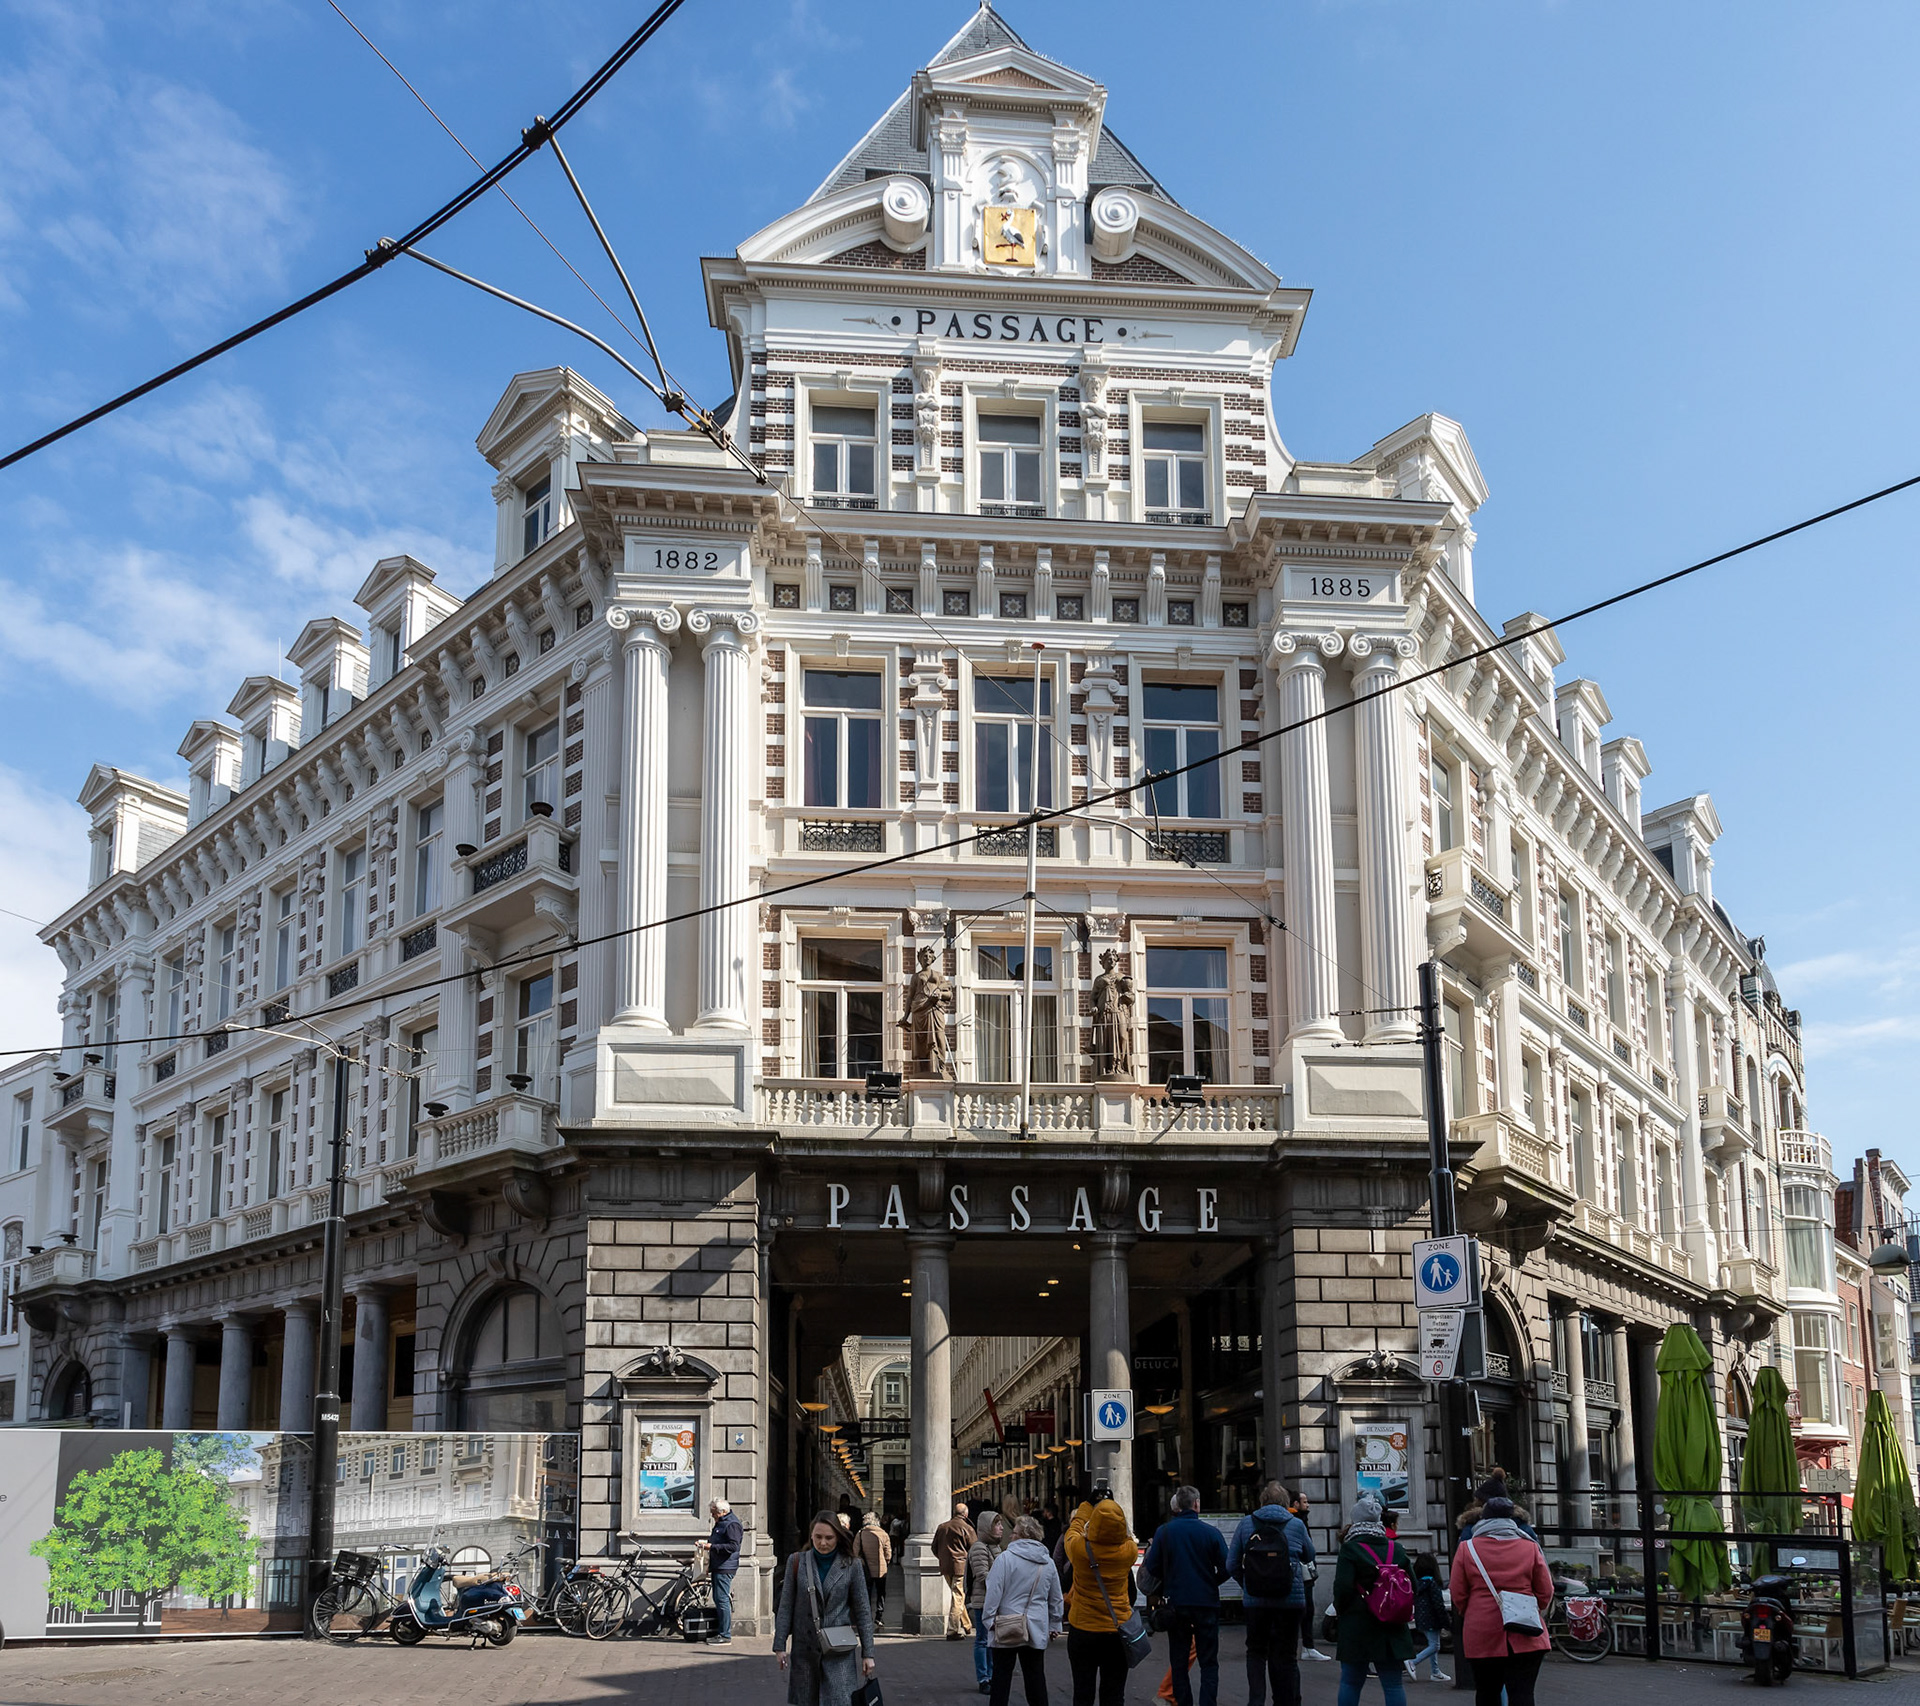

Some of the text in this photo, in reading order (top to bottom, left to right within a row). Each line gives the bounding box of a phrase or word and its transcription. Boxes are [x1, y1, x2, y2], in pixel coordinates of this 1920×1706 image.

[916, 309, 1105, 344] PASSAGE
[654, 548, 719, 572] 1882
[1310, 575, 1373, 599] 1885
[827, 1183, 1219, 1232] PASSAGE
[1427, 1242, 1451, 1252] ZONE
[643, 1463, 676, 1471] STYLISH
[1359, 1464, 1390, 1472] STYLISH
[1808, 1469, 1847, 1481] LEUK
